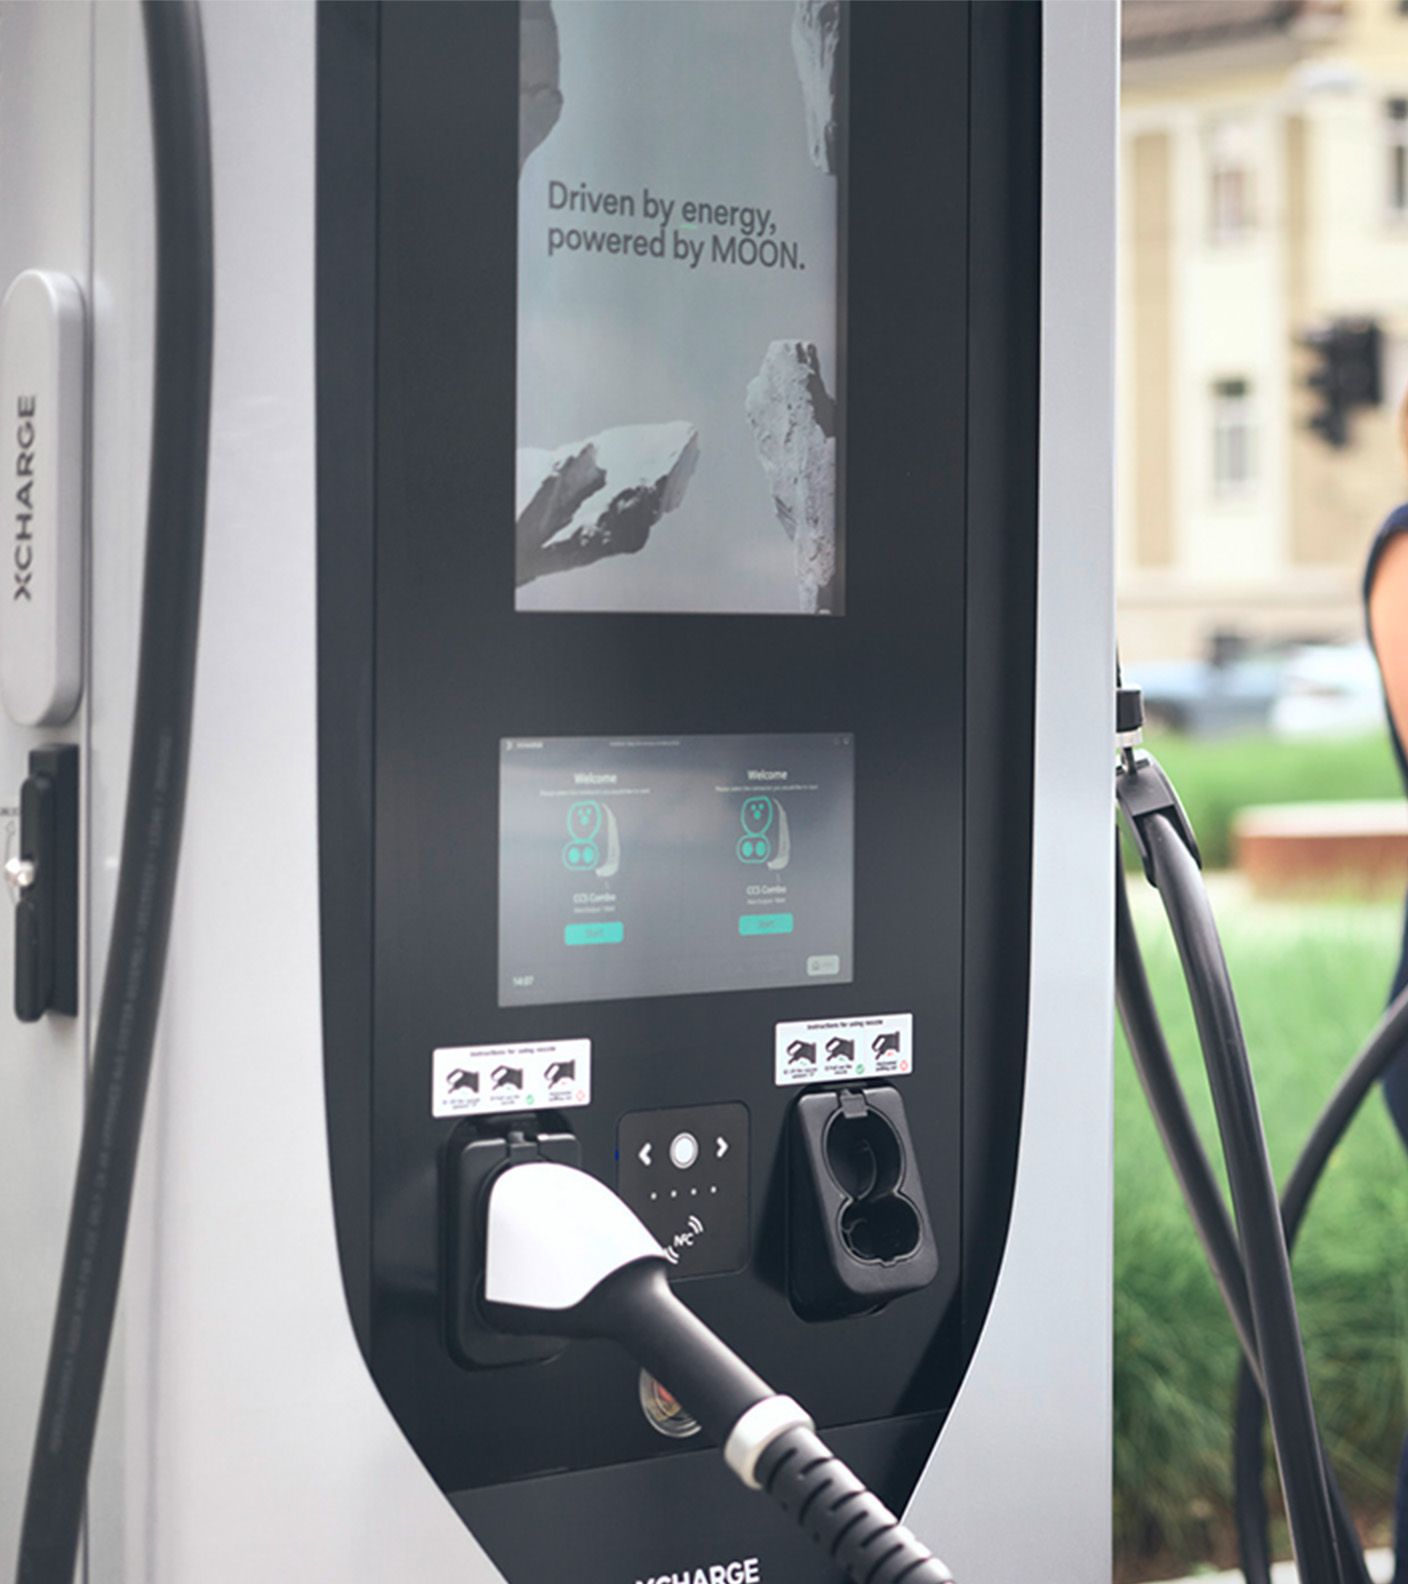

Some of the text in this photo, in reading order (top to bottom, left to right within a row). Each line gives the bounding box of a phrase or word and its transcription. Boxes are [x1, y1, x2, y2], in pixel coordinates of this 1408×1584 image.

[549, 180, 777, 237] Driven by energy,
[549, 227, 805, 270] powered by MOON.
[14, 395, 36, 601] XCHARGE
[574, 772, 617, 784] Welcome
[747, 770, 788, 781] Welcome
[673, 1233, 694, 1247] NFC
